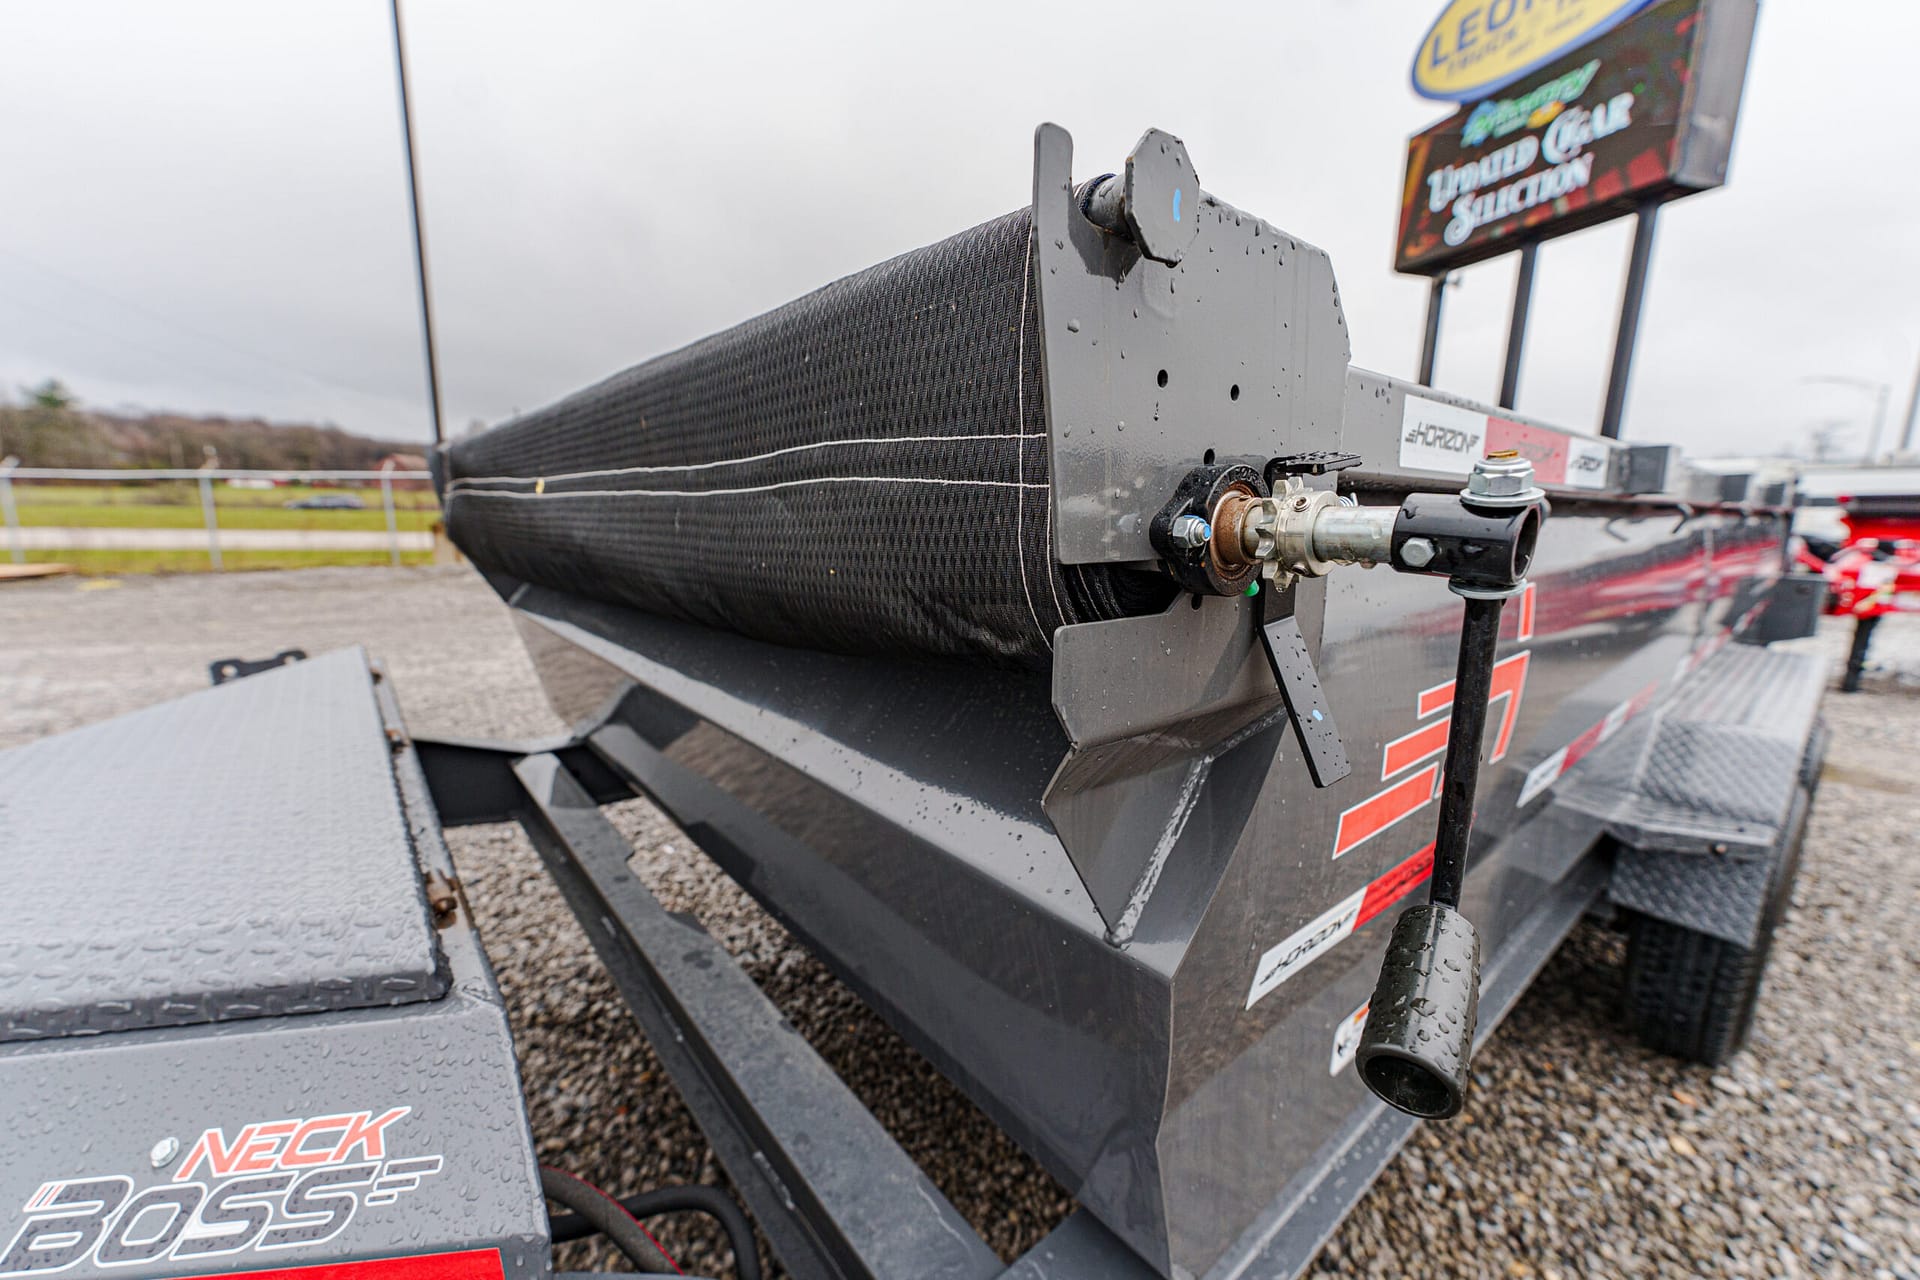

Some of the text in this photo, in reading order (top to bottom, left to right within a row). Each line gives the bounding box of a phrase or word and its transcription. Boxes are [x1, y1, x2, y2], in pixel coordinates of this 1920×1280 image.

[1430, 0, 1534, 68] LEO
[1409, 421, 1477, 454] HORIZON
[172, 1105, 412, 1182] NECK
[0, 1160, 384, 1277] BOSS
